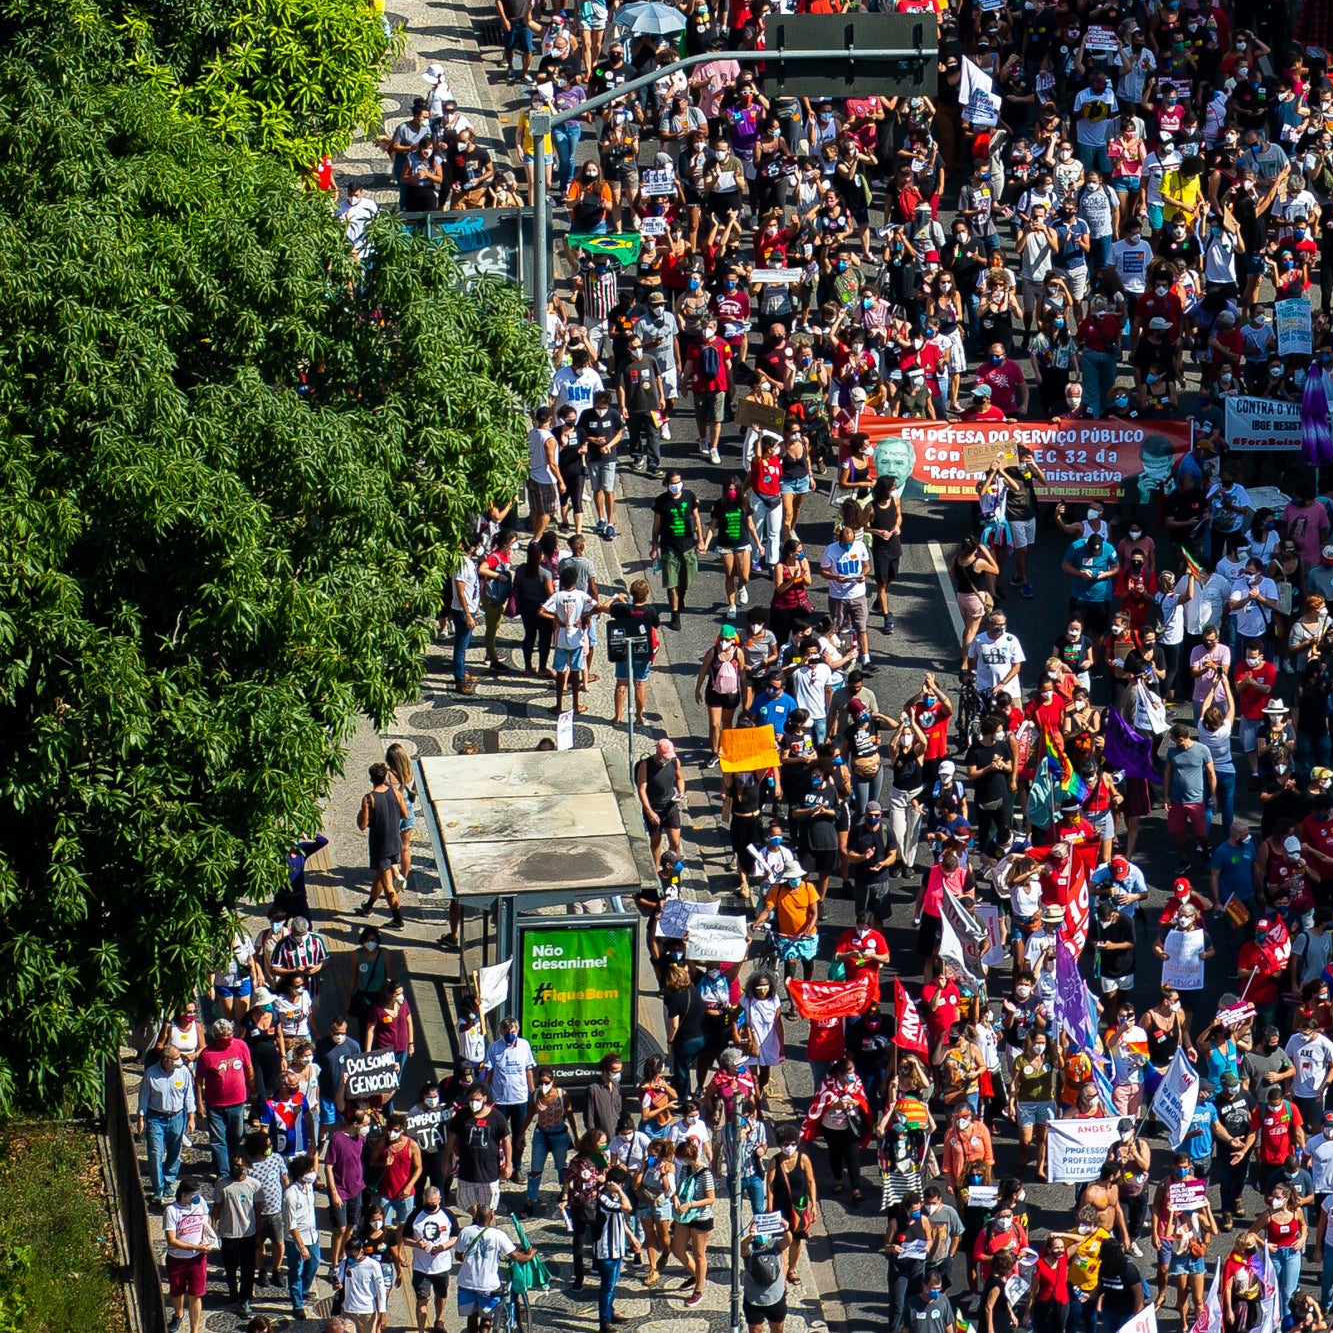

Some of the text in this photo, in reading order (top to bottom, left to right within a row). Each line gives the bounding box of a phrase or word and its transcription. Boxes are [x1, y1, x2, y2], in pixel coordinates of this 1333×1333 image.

[1236, 399, 1273, 416] CONTRA
[1275, 405, 1284, 416] O
[1251, 419, 1271, 431] IBGE
[1273, 420, 1302, 432] RESIST
[900, 426, 1145, 447] EM DEFESA DO SERVIÇO PÚBLICO
[1231, 436, 1302, 448] #ForaBolso
[923, 446, 1118, 464] Con EC 32 da
[531, 943, 556, 957] Não
[531, 956, 608, 970] desanime!
[531, 983, 620, 1005] #FiqueBem
[531, 1015, 613, 1028] Cuide de você
[531, 1028, 607, 1040] e também de
[531, 1041, 625, 1057] quem você ama.
[345, 1071, 402, 1096] GENOCIDA
[1077, 1125, 1112, 1133] ANDES
[1062, 1146, 1108, 1156] PROFESSOR
[1061, 1156, 1108, 1166] PROFESSOR
